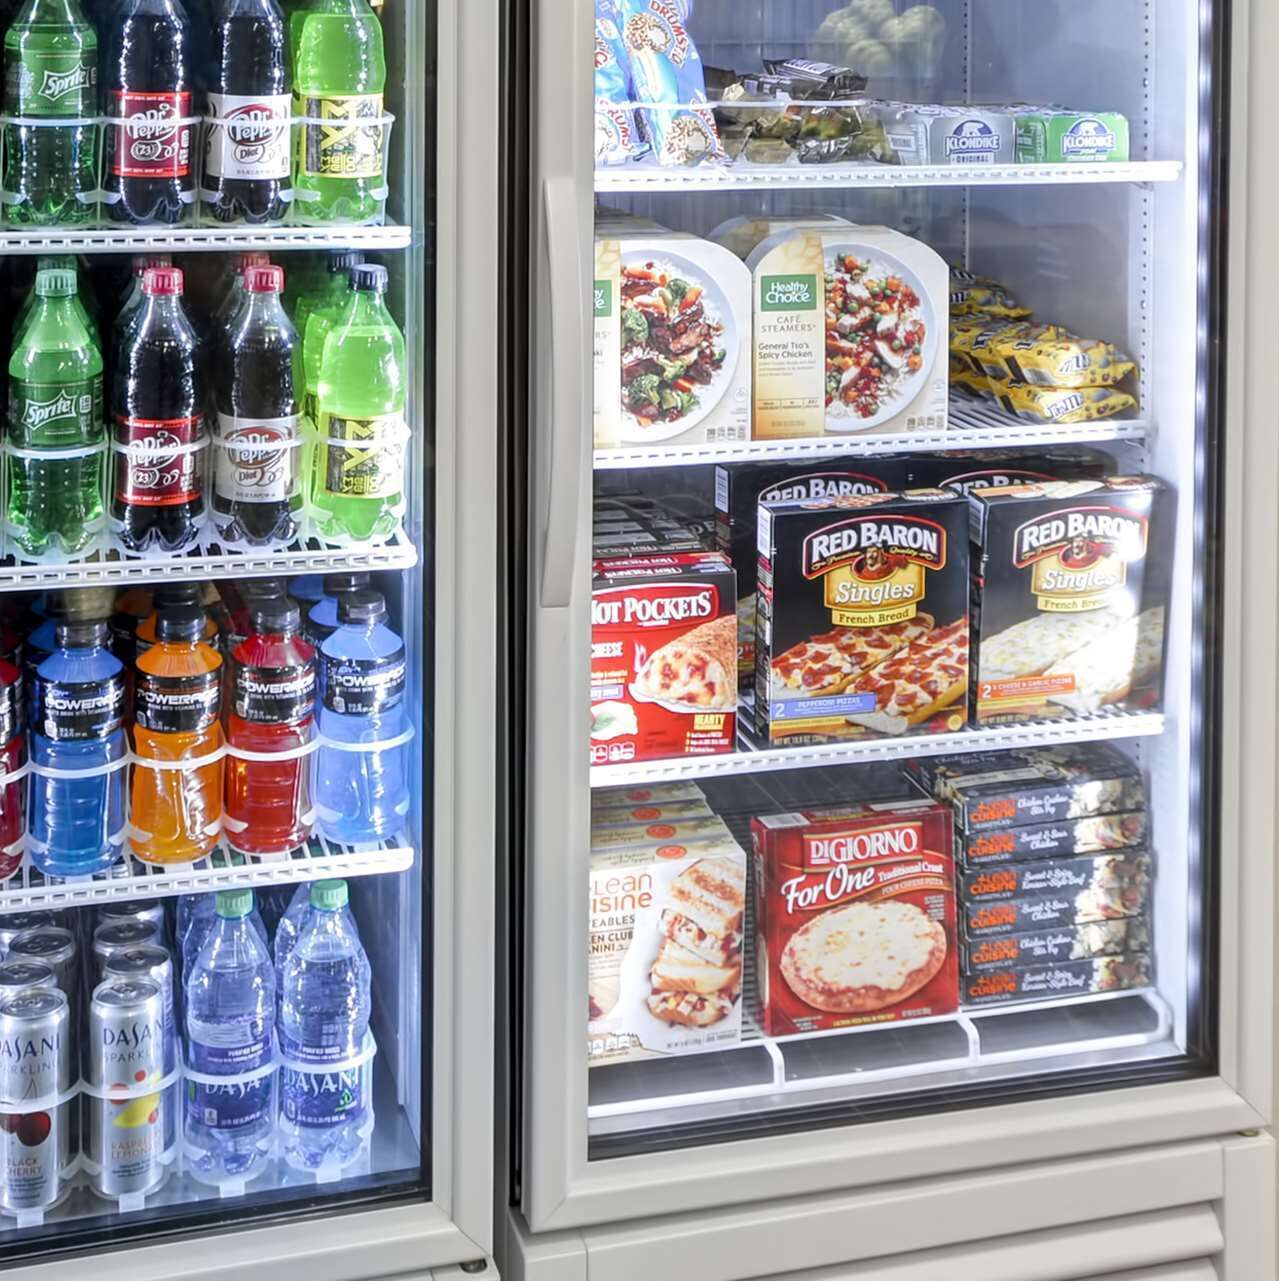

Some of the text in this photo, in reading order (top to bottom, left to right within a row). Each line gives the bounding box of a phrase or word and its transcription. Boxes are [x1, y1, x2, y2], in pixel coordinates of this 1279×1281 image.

[45, 70, 87, 95] Sprite
[945, 133, 1001, 155] KLONDIKE
[1062, 133, 1116, 155] KLONDIKE
[240, 148, 260, 159] Diet
[771, 281, 809, 294] Healthy
[765, 290, 812, 304] Choice
[761, 324, 813, 334] STEAMERS
[758, 341, 789, 351] General
[758, 350, 813, 360] Spicy Chicken
[29, 396, 71, 422] Sprite
[238, 471, 258, 482] Diet
[811, 522, 939, 562] RED BARON
[1021, 522, 1065, 553] RED
[1042, 570, 1117, 592] Singles
[835, 580, 914, 605] Singles
[623, 592, 712, 622] POCKETS
[1043, 598, 1080, 610] French
[838, 607, 909, 625] French Bread
[982, 684, 992, 698] 2
[775, 703, 785, 718] 2
[781, 874, 824, 913] For
[825, 863, 874, 900] One
[592, 914, 635, 928] EABLES
[611, 930, 634, 942] CLUB
[104, 1019, 162, 1047] DASA
